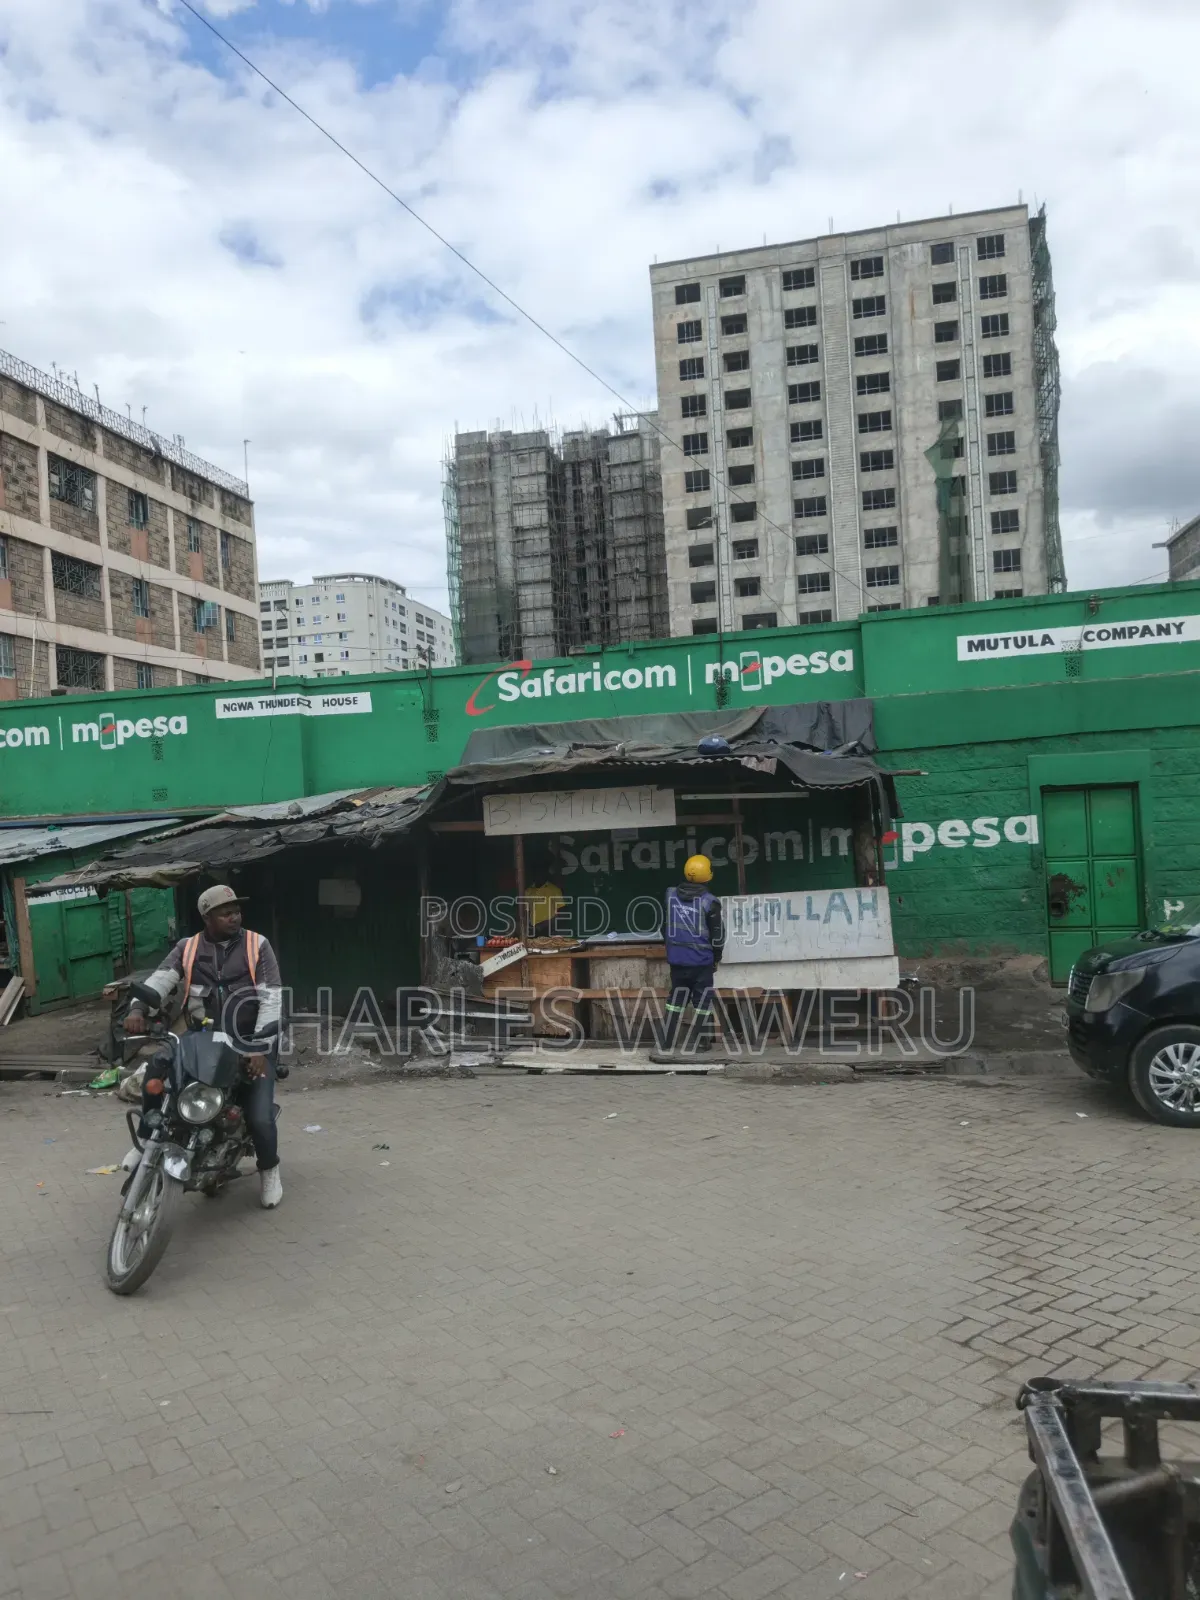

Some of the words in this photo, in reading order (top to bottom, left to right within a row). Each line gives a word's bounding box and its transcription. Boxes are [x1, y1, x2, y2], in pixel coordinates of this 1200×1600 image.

[967, 633, 1055, 653] MUTULA
[1083, 621, 1186, 643] COMPANY
[498, 662, 677, 702] Safaricom
[223, 702, 254, 713] NGWA
[258, 697, 317, 710] THUNDER
[322, 697, 358, 707] HOUSE
